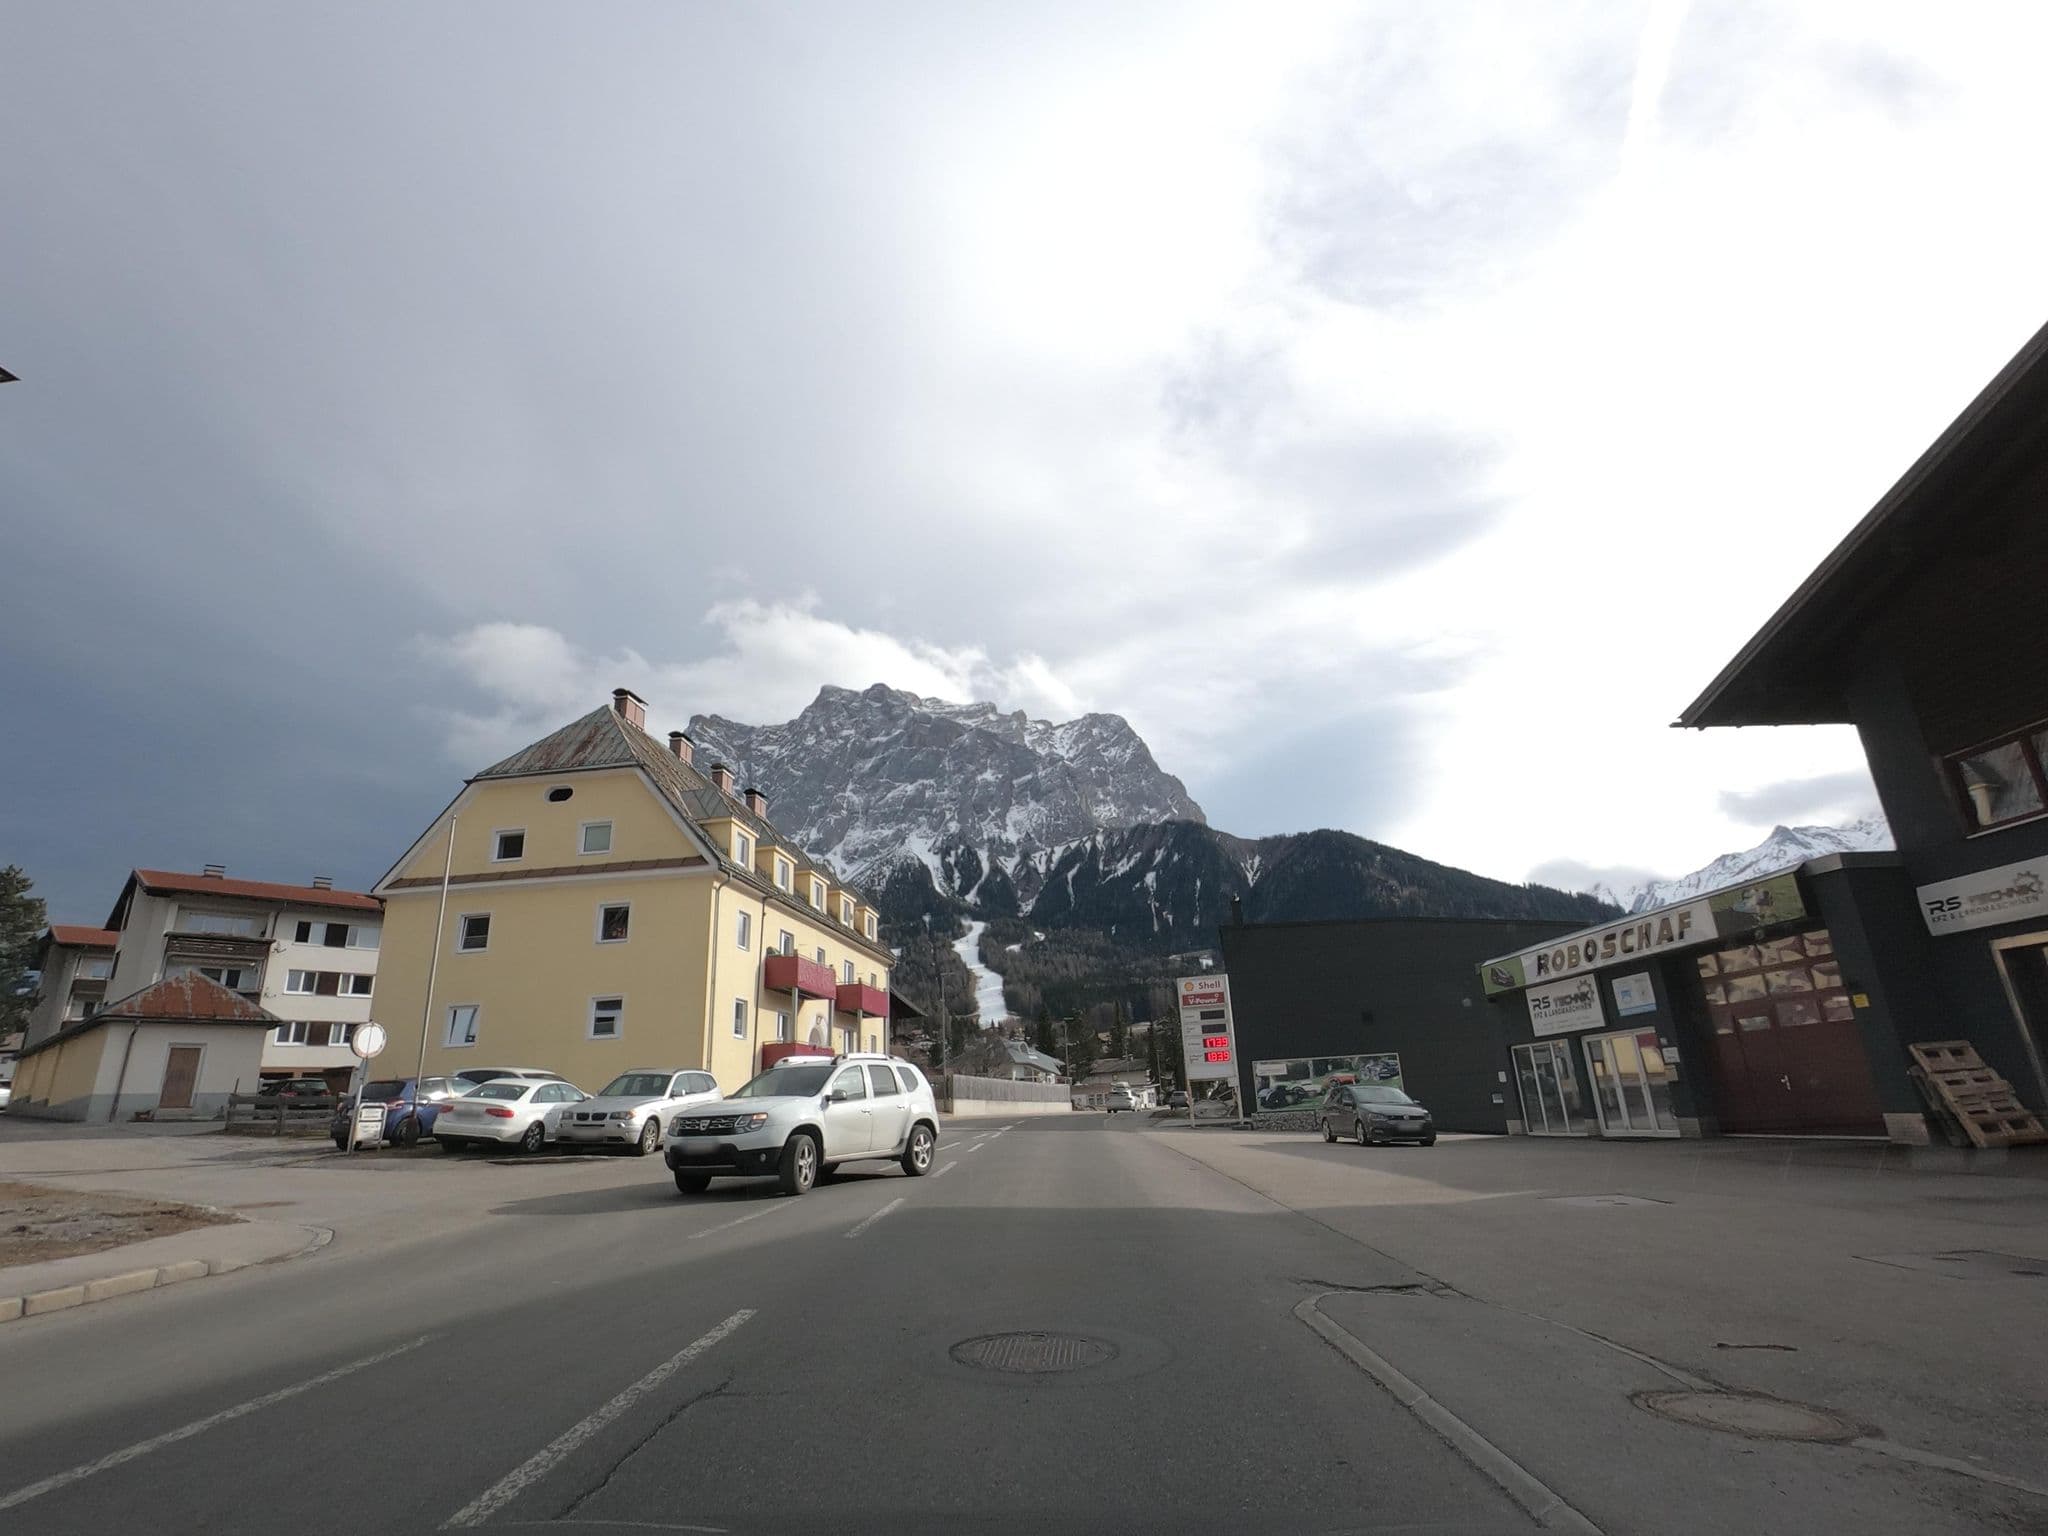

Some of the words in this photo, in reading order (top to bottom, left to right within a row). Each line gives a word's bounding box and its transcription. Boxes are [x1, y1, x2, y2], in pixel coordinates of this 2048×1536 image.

[1925, 896, 1961, 915] RS
[1536, 911, 1692, 976] ROBOSCHAF
[1199, 980, 1220, 990] Shell
[1531, 996, 1551, 1011] RS
